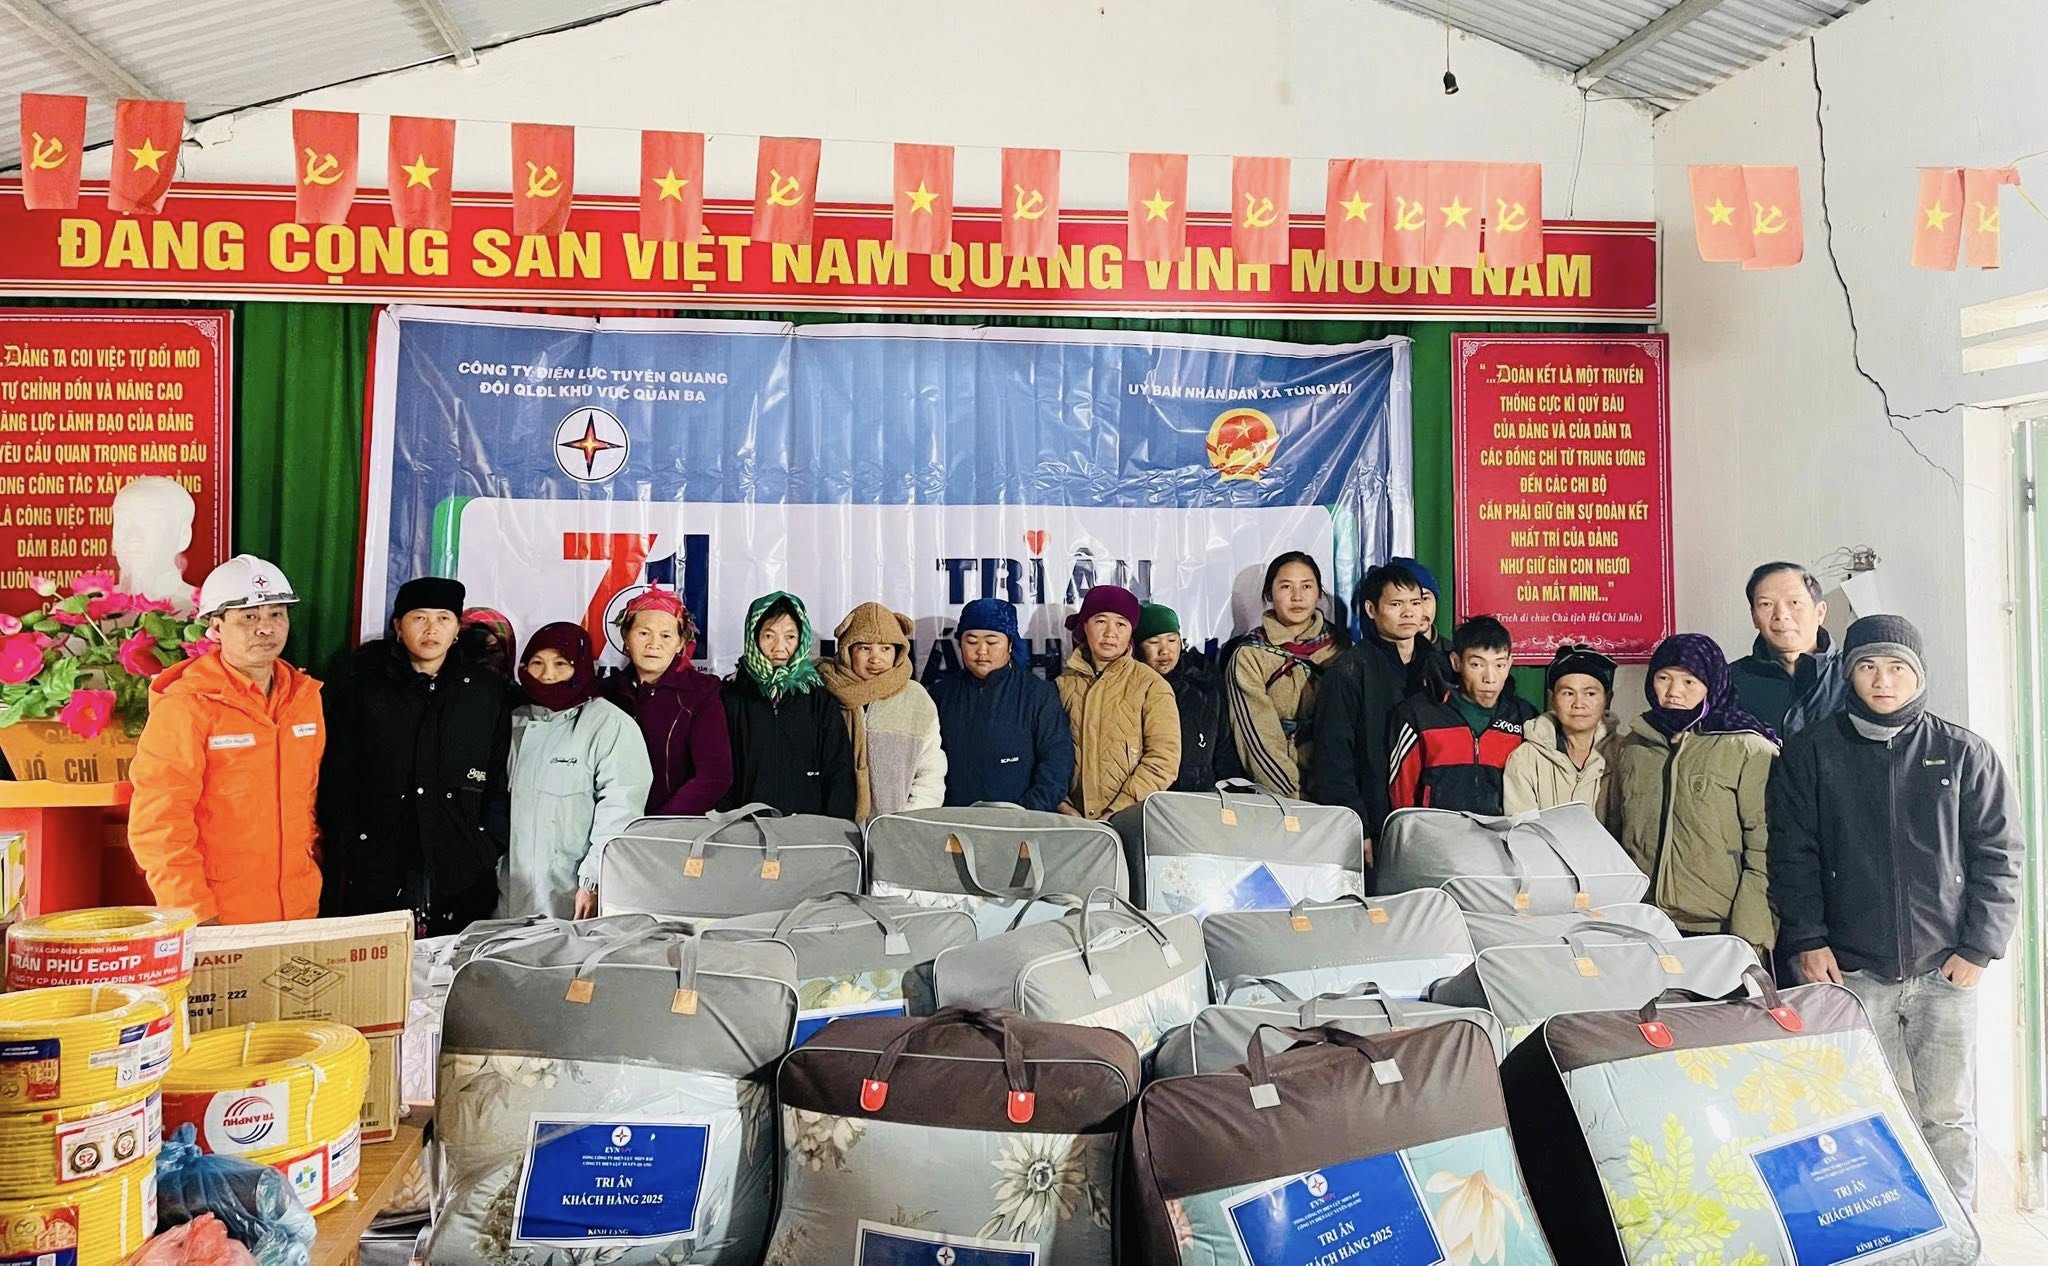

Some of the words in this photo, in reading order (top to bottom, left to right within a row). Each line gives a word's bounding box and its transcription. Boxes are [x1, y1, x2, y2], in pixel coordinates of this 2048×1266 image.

[772, 238, 908, 286] NAM
[930, 242, 1122, 292] QUANG
[53, 349, 67, 367] TA
[71, 349, 93, 367] COI
[97, 345, 126, 371] VIỆC
[129, 347, 147, 371] TỰ
[149, 343, 171, 367] ĐỔI
[175, 346, 200, 368] MỚI
[459, 360, 507, 376] CÔNG
[511, 365, 533, 377] TY
[578, 366, 607, 381] LỰC
[611, 368, 665, 383] TUYÊN
[670, 371, 728, 384] QUANG
[1537, 363, 1556, 384] KẾT
[1560, 365, 1573, 384] LÀ
[1576, 364, 1599, 387] MỘT
[2, 381, 18, 404] TỰ
[21, 376, 61, 400] CHỈNH
[96, 378, 113, 400] VÀ
[117, 379, 153, 400] NÂNG
[157, 382, 183, 400] CAO
[480, 380, 509, 397] ĐỘI
[559, 385, 593, 397] KHU
[1152, 385, 1181, 398] BAN
[1185, 386, 1226, 400] NHÂN
[1539, 394, 1561, 415] CỰC
[0, 409, 27, 432] ĂNG
[31, 412, 55, 435] LỰC
[59, 410, 94, 431] LÃNH
[97, 412, 124, 435] ĐẠO
[128, 407, 154, 432] CỦA
[158, 407, 194, 431] ĐẢNG
[1494, 418, 1516, 438] CỦA
[1519, 418, 1549, 438] ĐẢNG
[1552, 420, 1566, 438] VÀ
[1569, 418, 1591, 438] CỦA
[1594, 420, 1616, 438] DÂN
[1619, 423, 1632, 438] TA
[55, 444, 90, 465] QUAN
[94, 443, 137, 467] TRỌNG
[140, 440, 177, 463] HÀNG
[1480, 447, 1502, 466] CÁC
[1539, 446, 1557, 466] CHÍ
[1560, 448, 1575, 466] TỪ
[1577, 450, 1612, 466] TRUNG
[1615, 449, 1646, 466] ƯƠNG
[28, 472, 65, 495] CÔNG
[68, 472, 93, 494] TÁC
[97, 473, 121, 493] XÂY
[1520, 472, 1543, 493] ĐẾN
[1546, 474, 1568, 493] CÁC
[1571, 477, 1589, 493] CHI
[1592, 474, 1607, 496] BỘ
[16, 503, 51, 526] CÔNG
[56, 503, 84, 529] VIỆC
[1505, 499, 1531, 520] PHẢI
[1534, 501, 1553, 520] GIỮ
[1556, 501, 1575, 520] GÌN
[1578, 503, 1594, 523] SỰ
[1595, 501, 1626, 520] ĐOÀN
[1629, 499, 1649, 520] KẾT
[17, 533, 47, 557] ĐẢM
[51, 533, 77, 557] BẢO
[81, 538, 107, 556] CHO
[1511, 525, 1540, 547] NHẤT
[1543, 528, 1560, 547] TRÍ
[1563, 526, 1585, 547] CỦA
[1588, 526, 1618, 547] ĐẢNG
[1500, 556, 1524, 575] NHƯ
[1526, 555, 1546, 575] GIỮ
[1570, 558, 1593, 575] CON
[1517, 580, 1539, 601] CỦA
[1542, 579, 1565, 601] MẮT
[46, 955, 83, 973] PHÚ
[87, 954, 143, 973] EcoTP
[350, 948, 367, 962] BD
[371, 945, 388, 960] 09
[227, 990, 247, 1000] 222
[189, 1008, 204, 1017] 50
[595, 1177, 614, 1188] TRI
[617, 1175, 633, 1188] ÂN
[1834, 1184, 1853, 1200] TRI
[1851, 1179, 1867, 1196] ÂN
[562, 1192, 606, 1206] KHÁCH
[607, 1191, 639, 1205] HÀNG
[640, 1194, 663, 1205] 2025
[1817, 1207, 1853, 1227] KHÁCH
[1852, 1195, 1882, 1217] HÀNG
[1880, 1189, 1901, 1206] 2025
[1317, 1228, 1339, 1247] TRI
[1338, 1221, 1355, 1238] ÂN
[1338, 1237, 1371, 1260] HÀNG
[1370, 1225, 1393, 1245] 2025
